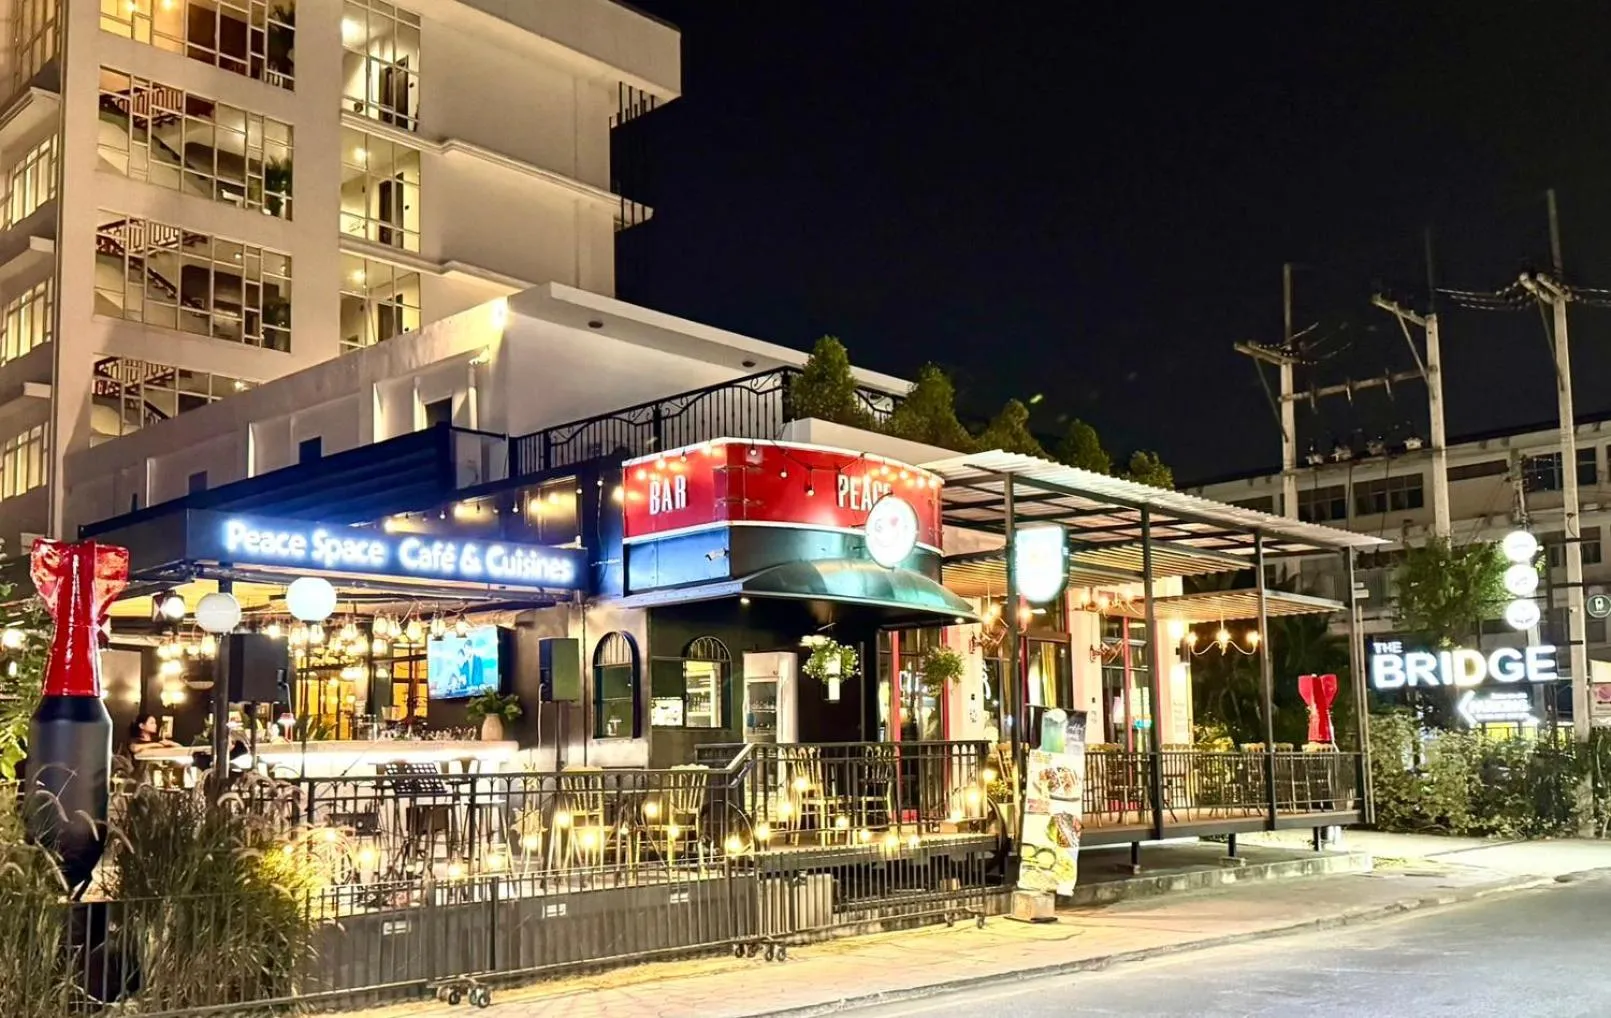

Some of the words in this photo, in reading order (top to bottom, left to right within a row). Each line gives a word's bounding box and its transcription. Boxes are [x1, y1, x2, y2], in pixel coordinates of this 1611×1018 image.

[649, 475, 686, 515] BAR
[225, 518, 307, 558] Peace
[311, 527, 387, 568] Space
[398, 536, 457, 573] Café
[460, 543, 482, 575] &
[485, 544, 575, 584] Cuisines
[1372, 645, 1558, 689] BRIDGE
[1373, 641, 1402, 654] THE
